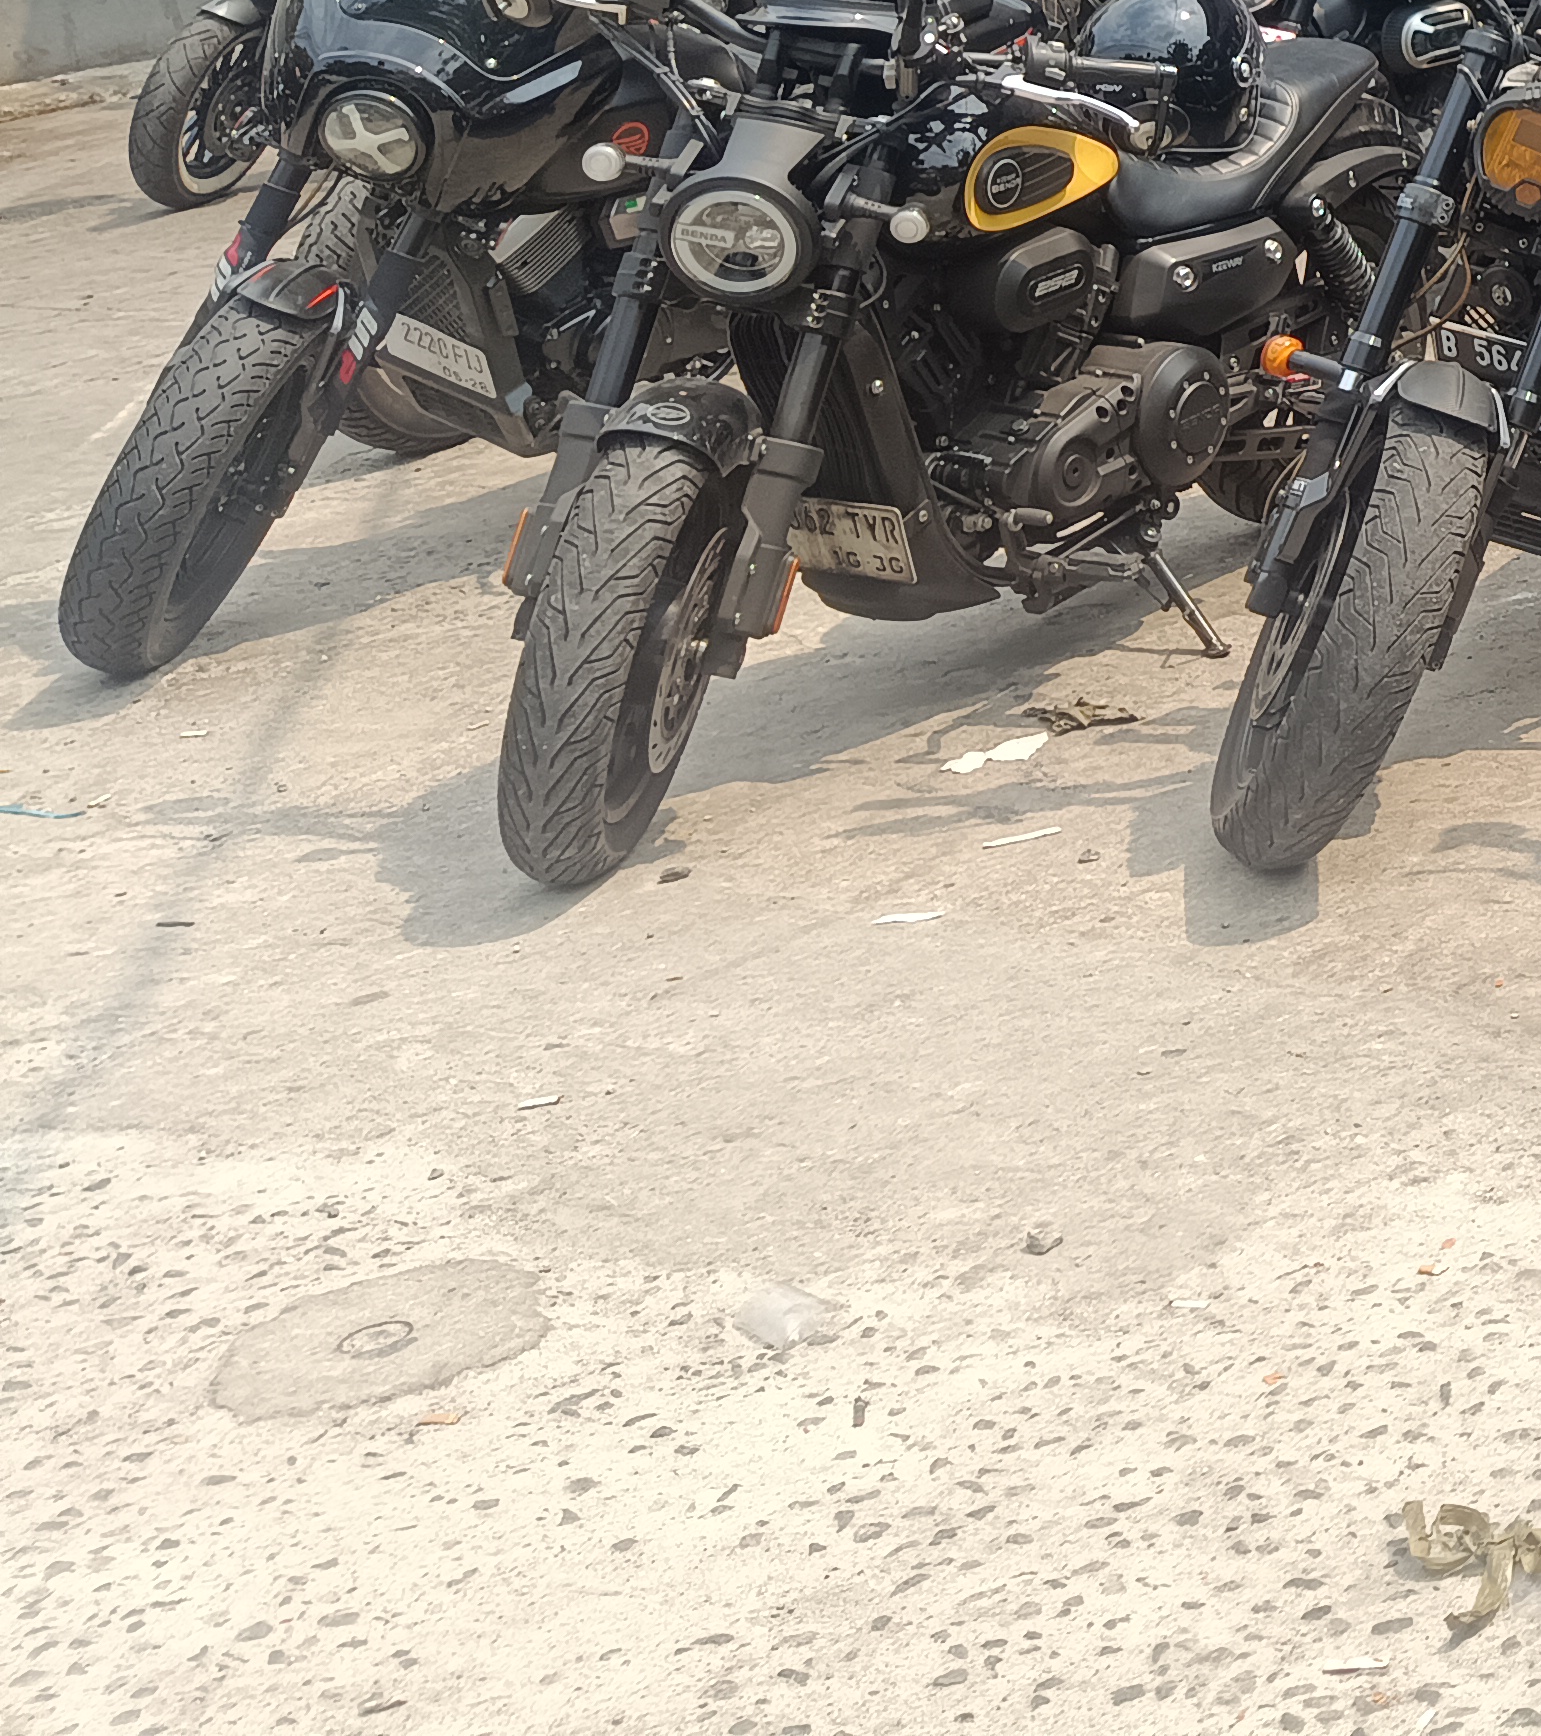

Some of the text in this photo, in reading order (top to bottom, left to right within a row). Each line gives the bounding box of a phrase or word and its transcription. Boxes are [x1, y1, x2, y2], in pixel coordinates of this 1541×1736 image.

[680, 227, 728, 245] BENDA
[1440, 329, 1458, 358] B
[844, 506, 899, 545] TYR
